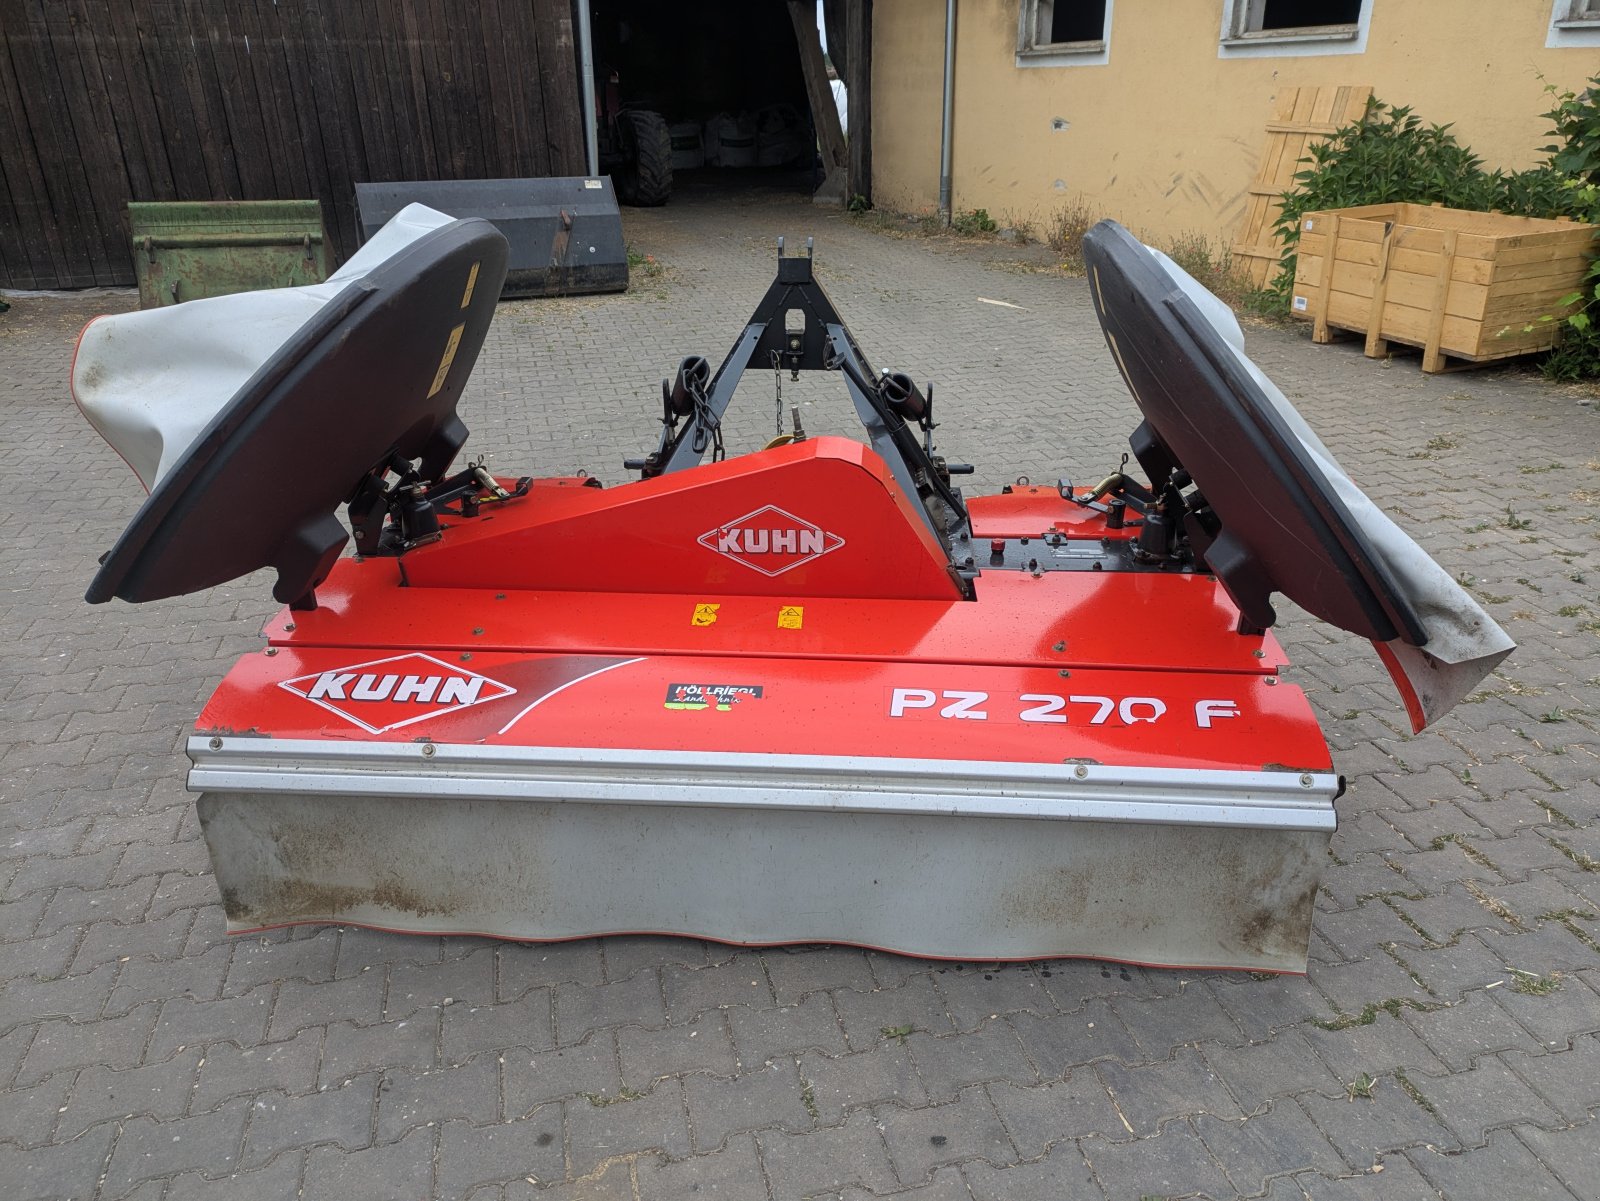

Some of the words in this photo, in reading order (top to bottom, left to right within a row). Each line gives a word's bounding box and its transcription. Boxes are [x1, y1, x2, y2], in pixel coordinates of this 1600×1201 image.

[718, 528, 824, 553] KUHN
[307, 672, 485, 704] KUHN
[890, 688, 988, 719] PZ
[1019, 694, 1167, 725] 270
[1195, 700, 1241, 728] F
